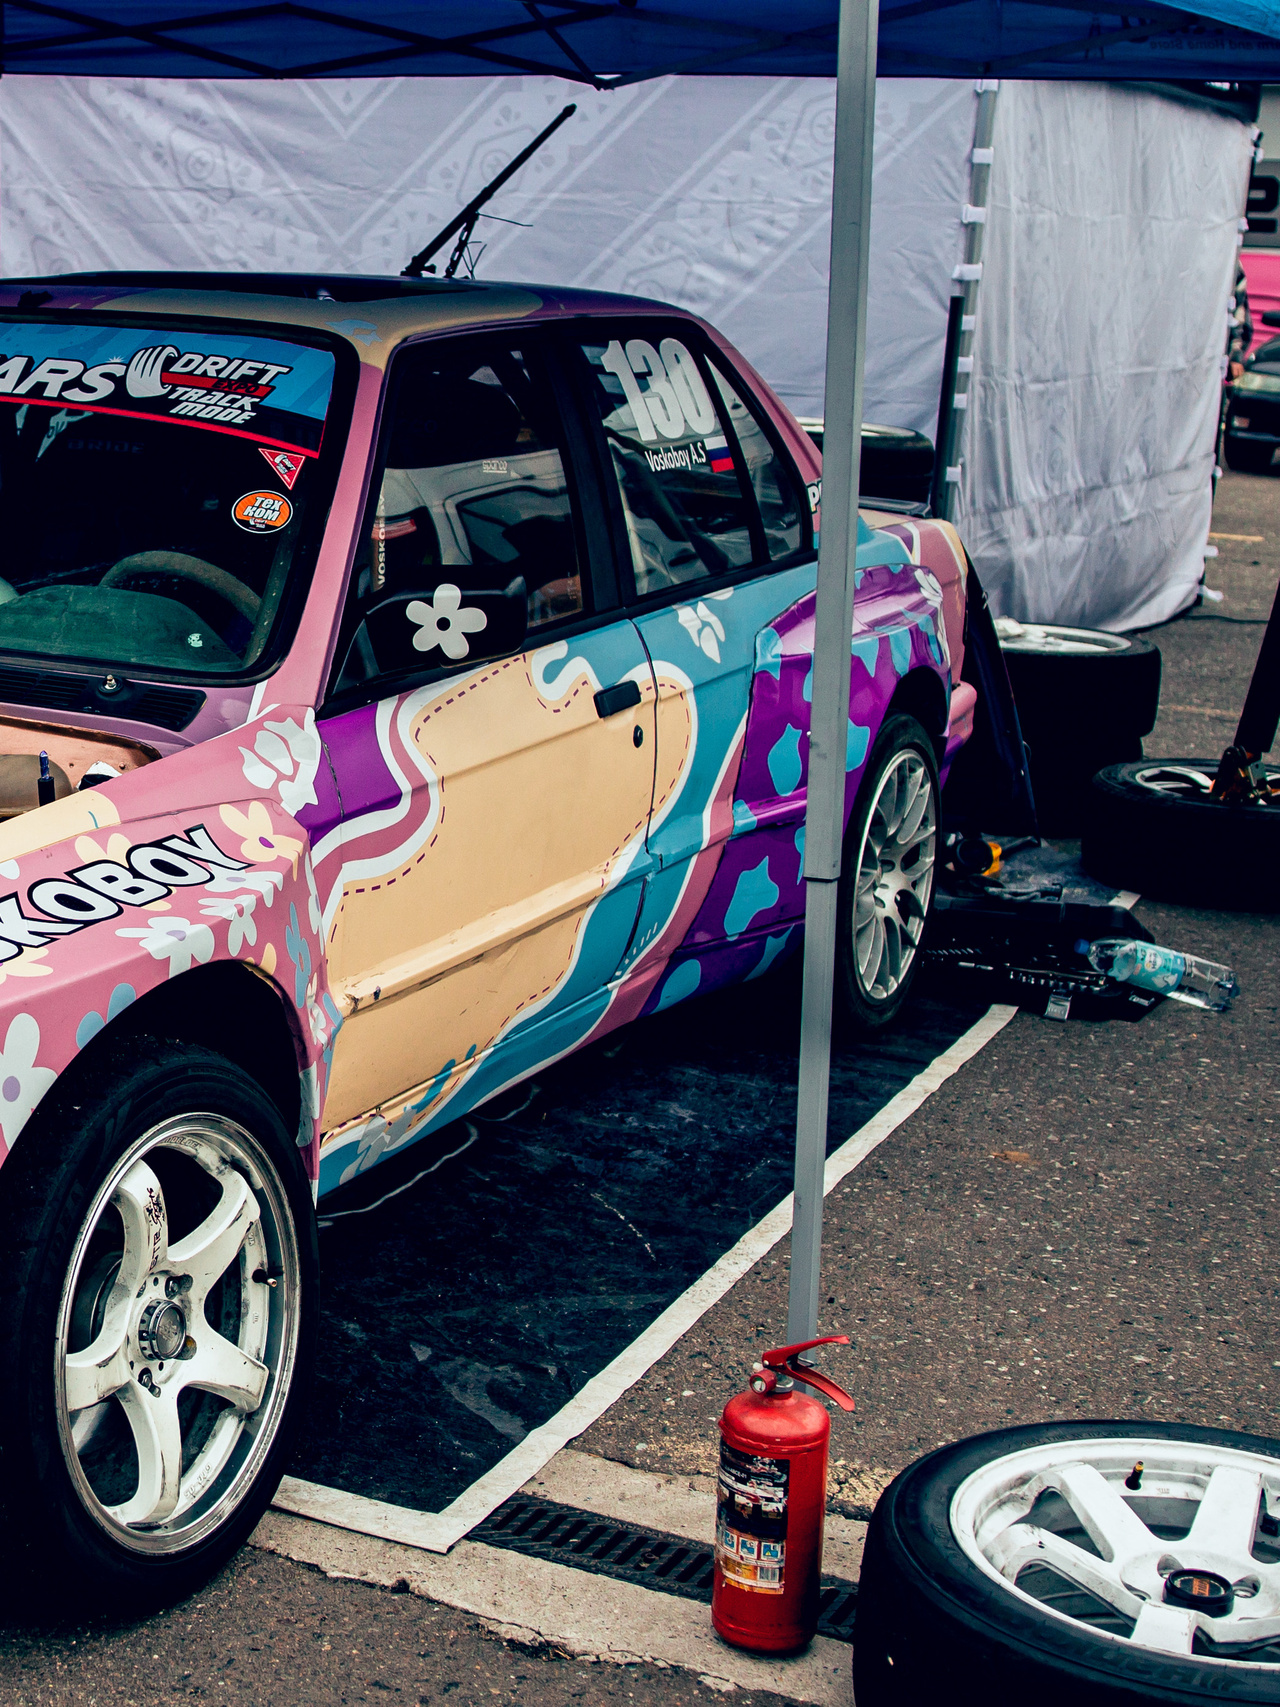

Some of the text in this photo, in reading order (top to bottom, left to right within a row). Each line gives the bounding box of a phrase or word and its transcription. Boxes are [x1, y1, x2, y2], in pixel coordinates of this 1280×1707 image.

[169, 353, 290, 385] DRIFT
[211, 380, 260, 394] EXPO
[600, 338, 716, 441] 130
[169, 401, 257, 424] MODE
[645, 445, 692, 473] Voskoboy
